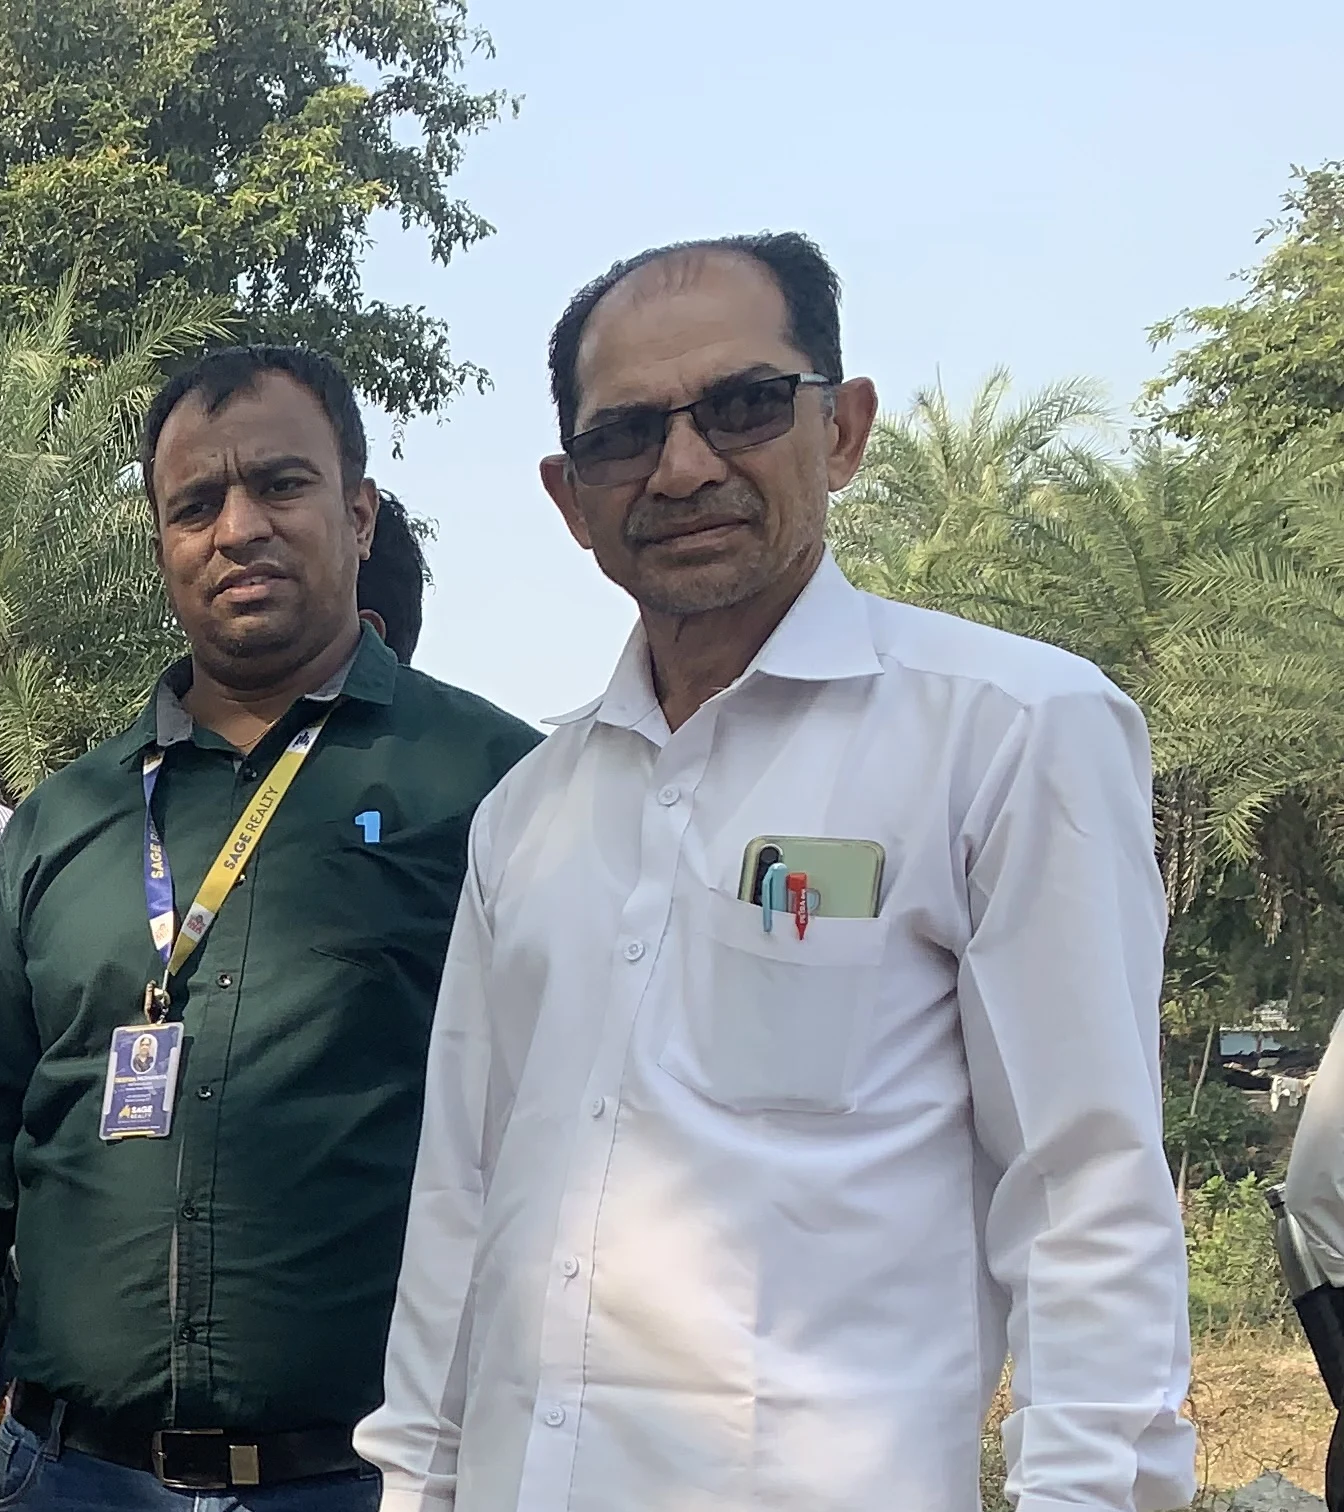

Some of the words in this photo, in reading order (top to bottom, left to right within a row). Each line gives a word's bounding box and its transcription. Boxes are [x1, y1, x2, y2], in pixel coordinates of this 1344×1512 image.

[223, 833, 252, 870] SAGE
[245, 785, 279, 832] REALTY
[150, 842, 164, 879] SAGE
